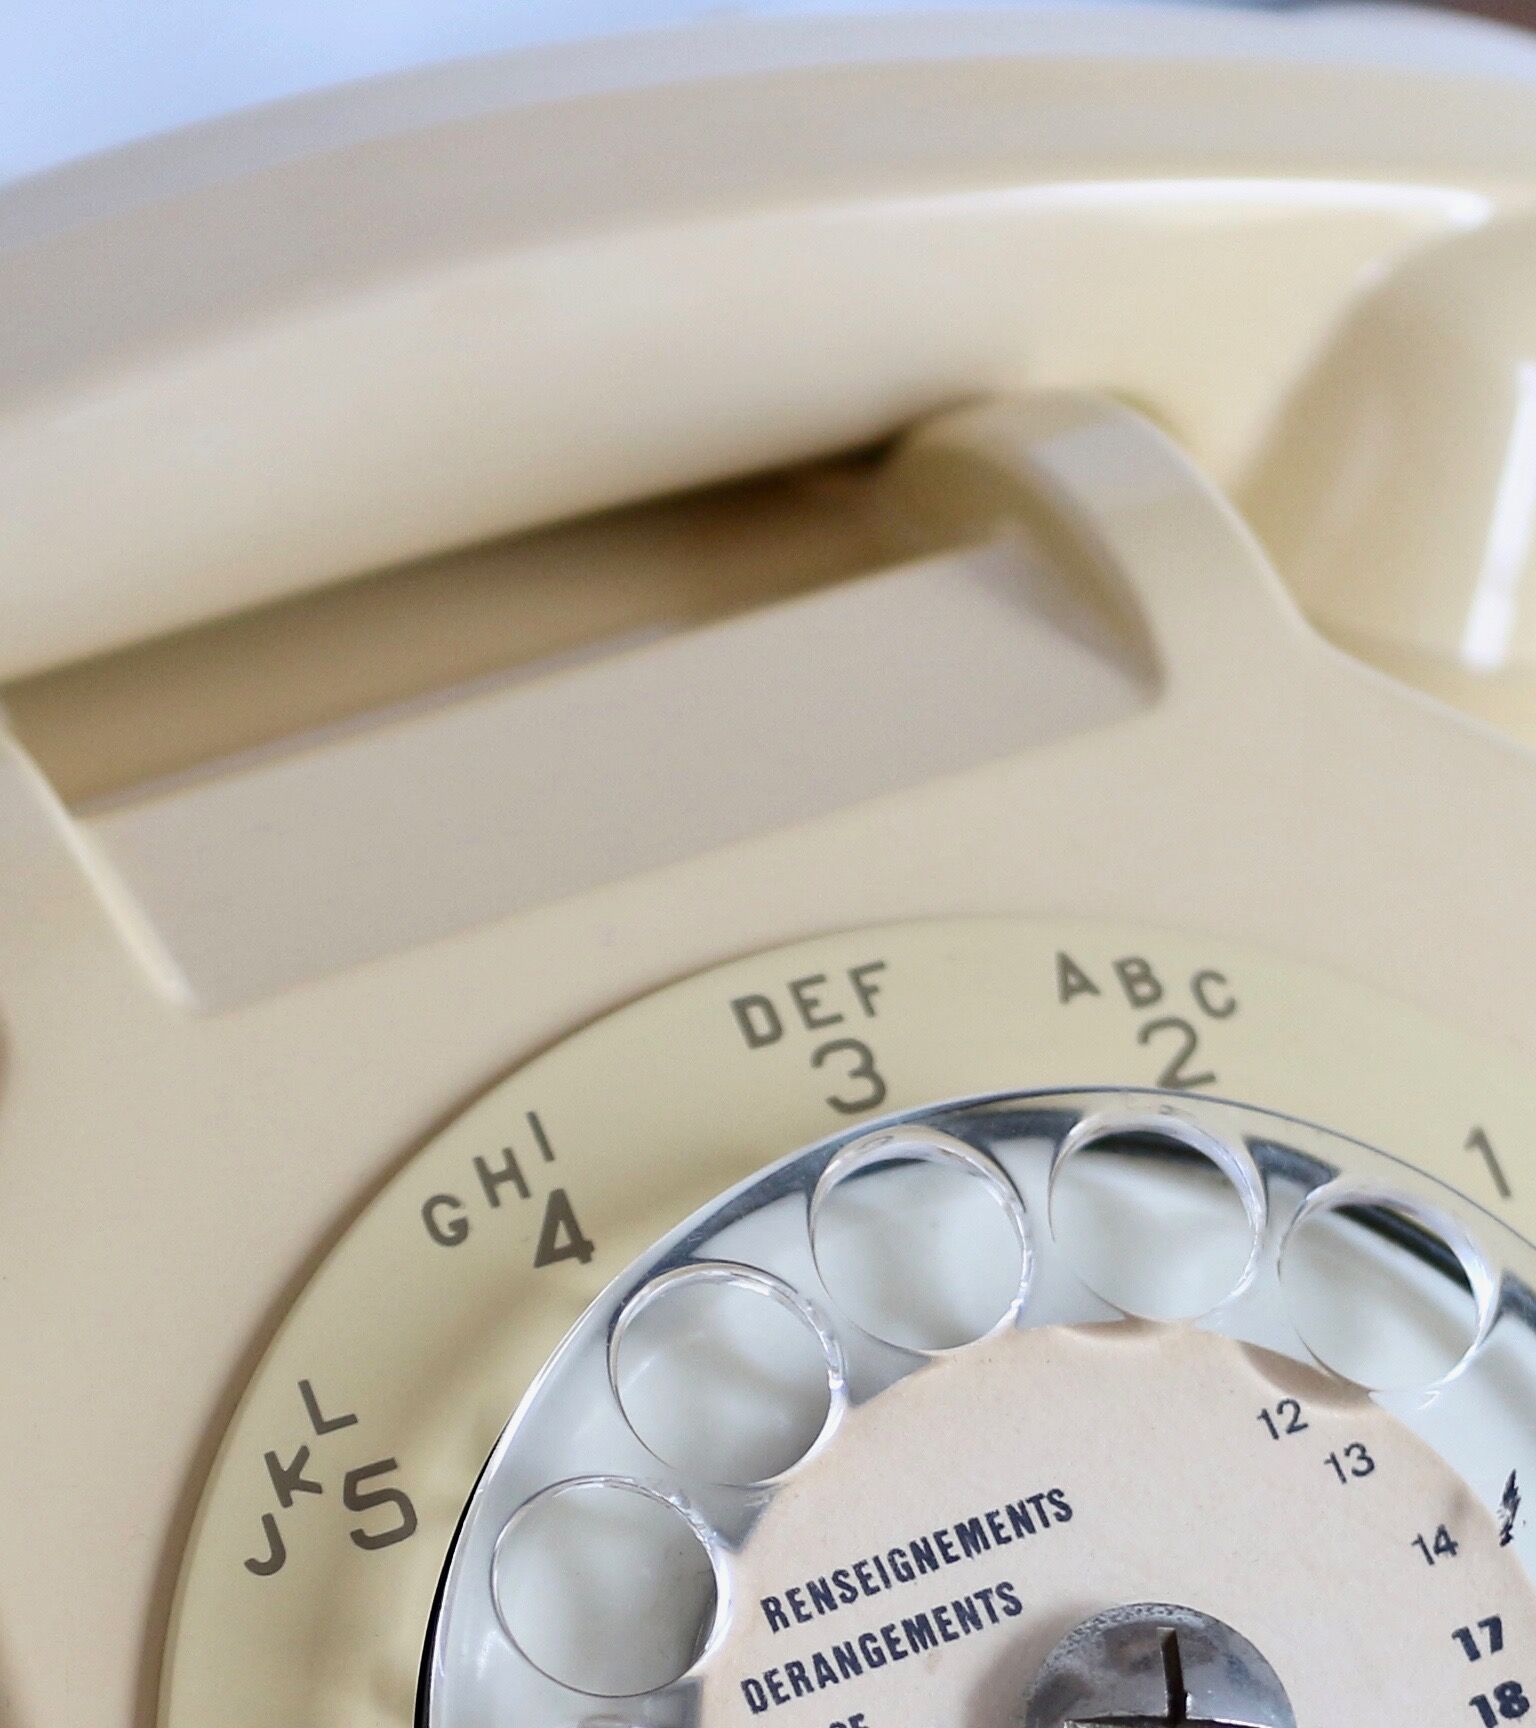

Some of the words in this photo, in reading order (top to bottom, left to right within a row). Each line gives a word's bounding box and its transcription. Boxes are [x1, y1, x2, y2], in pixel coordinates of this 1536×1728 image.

[729, 961, 886, 1050] DEF
[810, 1037, 887, 1114] 3
[1137, 1016, 1216, 1090] 2
[421, 1110, 557, 1247] GHI
[1463, 1126, 1512, 1199] 1
[533, 1188, 595, 1268] 4
[1257, 1398, 1309, 1441] 12
[1324, 1441, 1375, 1484] 13
[343, 1457, 418, 1550] 5
[760, 1487, 1075, 1634] RENSEIGNEMENTS
[1412, 1523, 1459, 1566] 14
[740, 1580, 1024, 1715] DERANGEMENTS
[1451, 1613, 1504, 1662] 17
